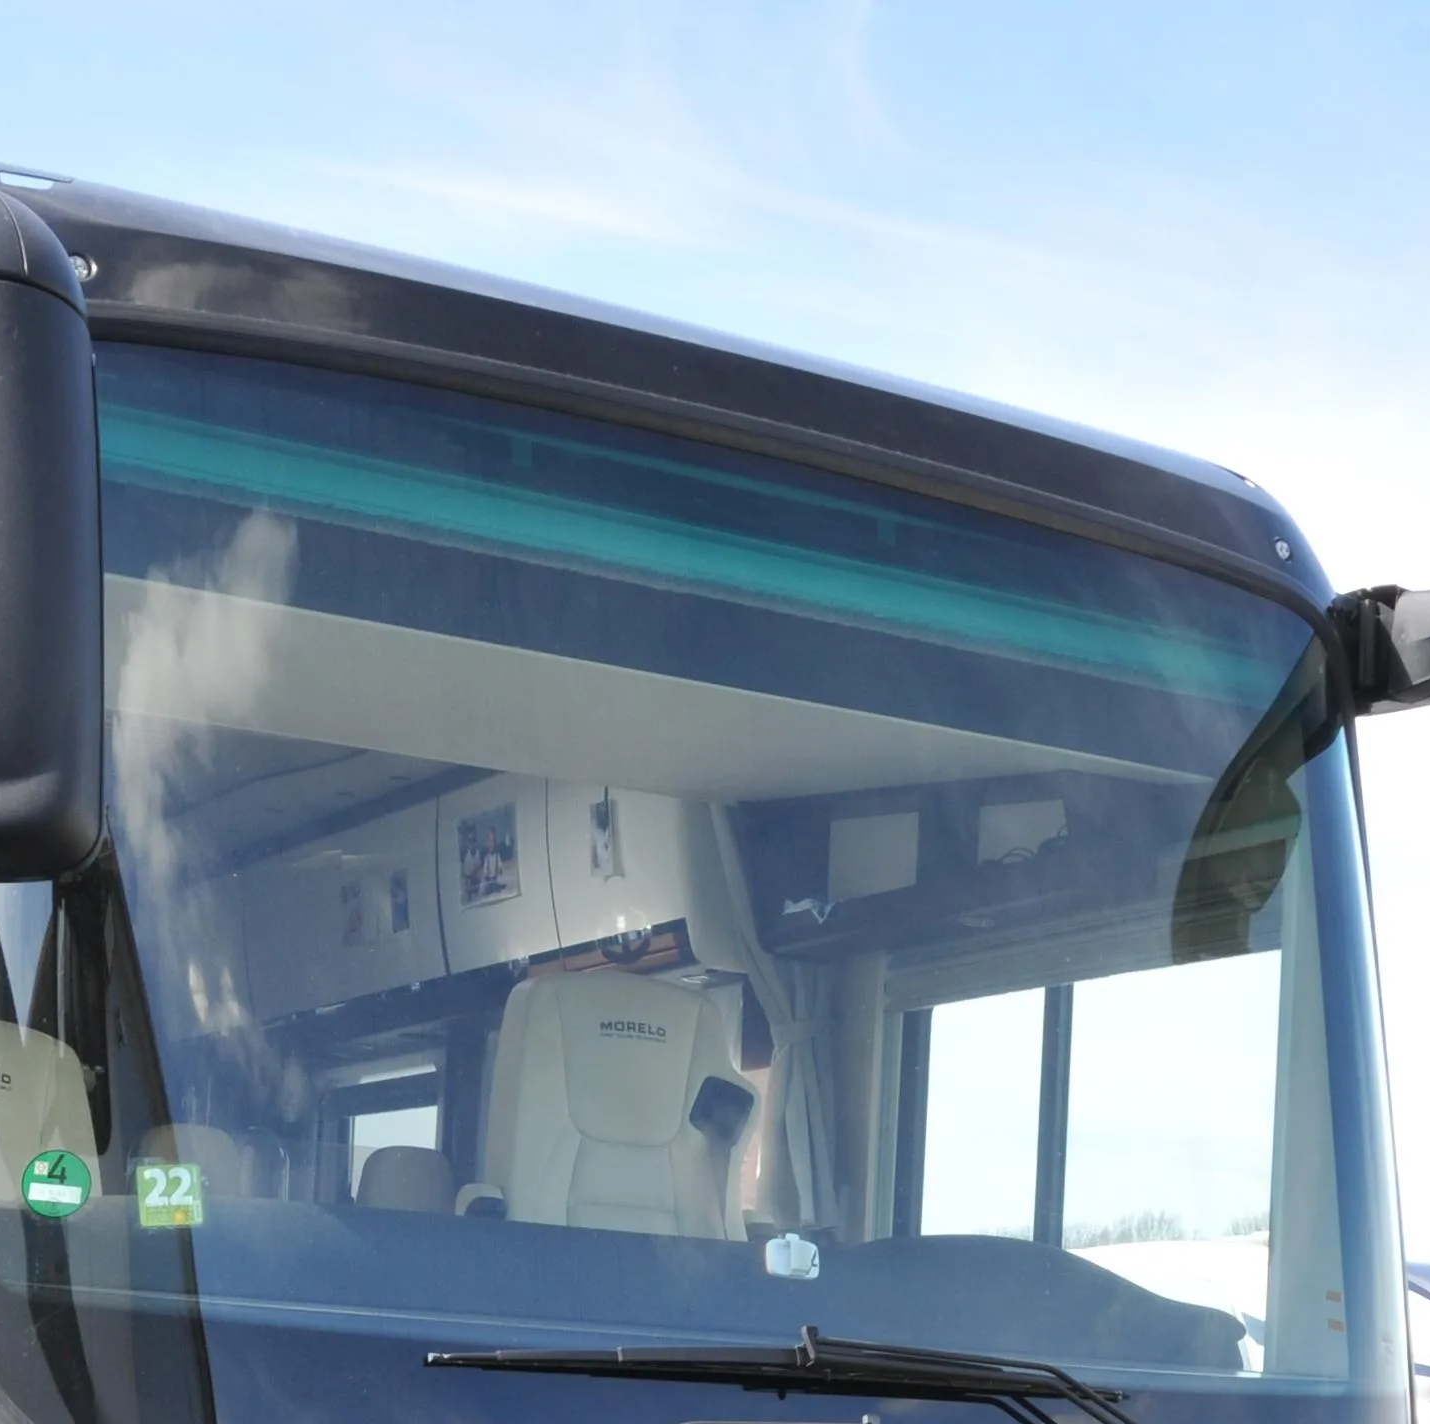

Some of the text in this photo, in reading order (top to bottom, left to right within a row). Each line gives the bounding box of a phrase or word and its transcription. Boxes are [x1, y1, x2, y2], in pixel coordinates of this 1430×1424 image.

[600, 1020, 667, 1037] MORELO
[47, 1154, 67, 1185] 4
[143, 1167, 193, 1208] 22
